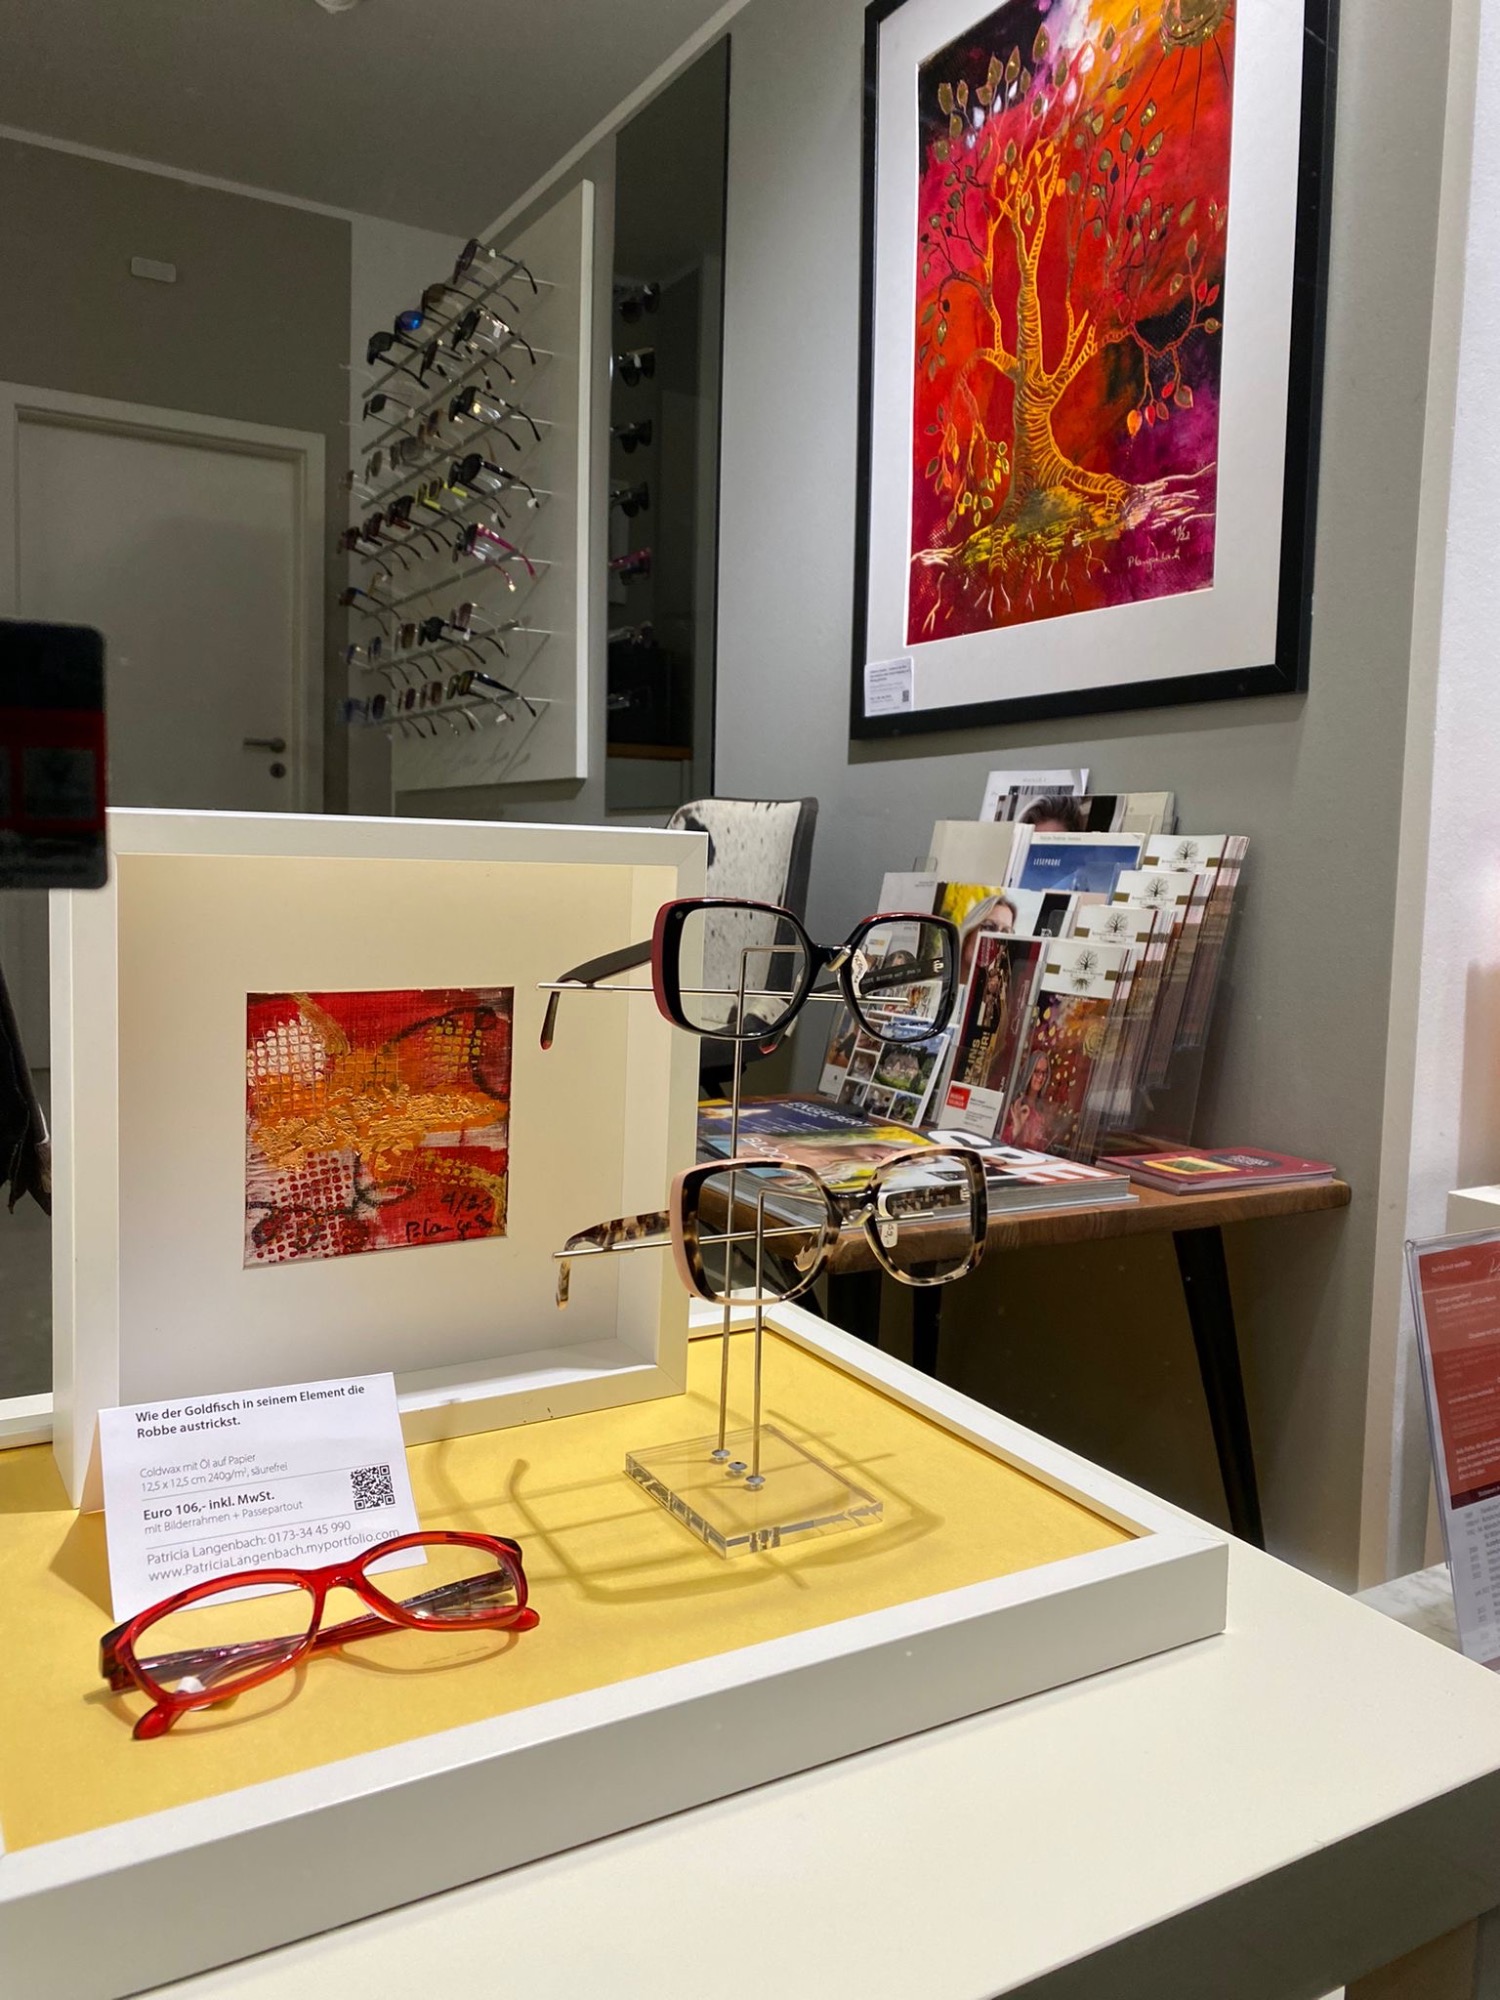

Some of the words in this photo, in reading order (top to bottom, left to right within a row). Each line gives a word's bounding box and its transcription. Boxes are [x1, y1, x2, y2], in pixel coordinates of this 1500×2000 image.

[1033, 857, 1061, 867] LESEPROBE
[135, 1411, 158, 1422] Wie
[161, 1408, 181, 1419] der
[184, 1399, 239, 1416] Goldfisch
[242, 1399, 253, 1408] in
[256, 1394, 297, 1407] seinem
[299, 1387, 345, 1401] Element
[347, 1384, 364, 1395] die
[136, 1424, 176, 1438] Robbe
[179, 1416, 240, 1432] austrickst.
[139, 1465, 181, 1478] Coldwax
[182, 1461, 198, 1472] mit
[199, 1458, 210, 1469] Öl
[212, 1455, 226, 1468] auf
[227, 1453, 255, 1465] Papier
[162, 1481, 168, 1489] x
[190, 1475, 206, 1484] cm
[250, 1461, 287, 1476] säurefrei
[143, 1508, 172, 1520] Euro
[175, 1502, 206, 1514] 106,-
[208, 1496, 235, 1509] inkl.
[237, 1491, 274, 1505] MwSt.
[144, 1523, 161, 1534] mit
[163, 1513, 230, 1531] Bilderrahmen
[232, 1511, 239, 1519] +
[241, 1500, 302, 1517] Passepartout
[146, 1548, 189, 1564] Patricia
[192, 1535, 266, 1557] Langenbach:
[267, 1527, 309, 1543] 0173-34
[311, 1523, 328, 1536] 45
[330, 1520, 351, 1533] 990
[148, 1529, 401, 1581] www.PatriciaLangenbach.myportfolio.com
